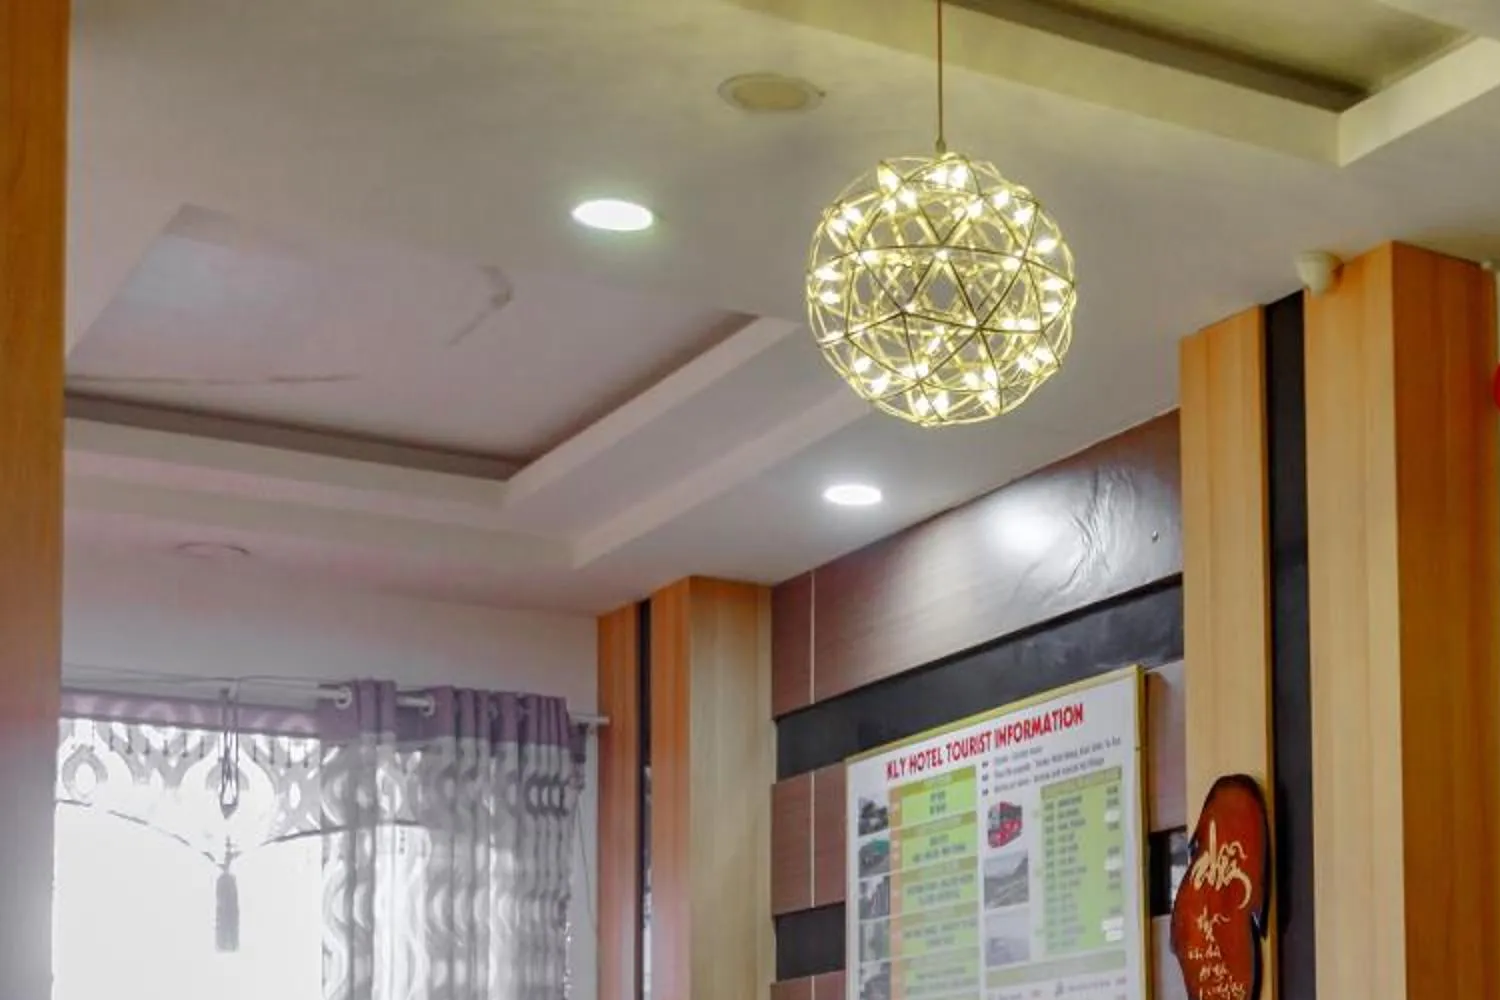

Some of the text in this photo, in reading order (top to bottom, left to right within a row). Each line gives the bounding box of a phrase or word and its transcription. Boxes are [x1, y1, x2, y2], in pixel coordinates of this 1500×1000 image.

[908, 749, 943, 775] HOTEL
[945, 731, 993, 763] TOURIST
[994, 703, 1085, 749] INFORMATION
